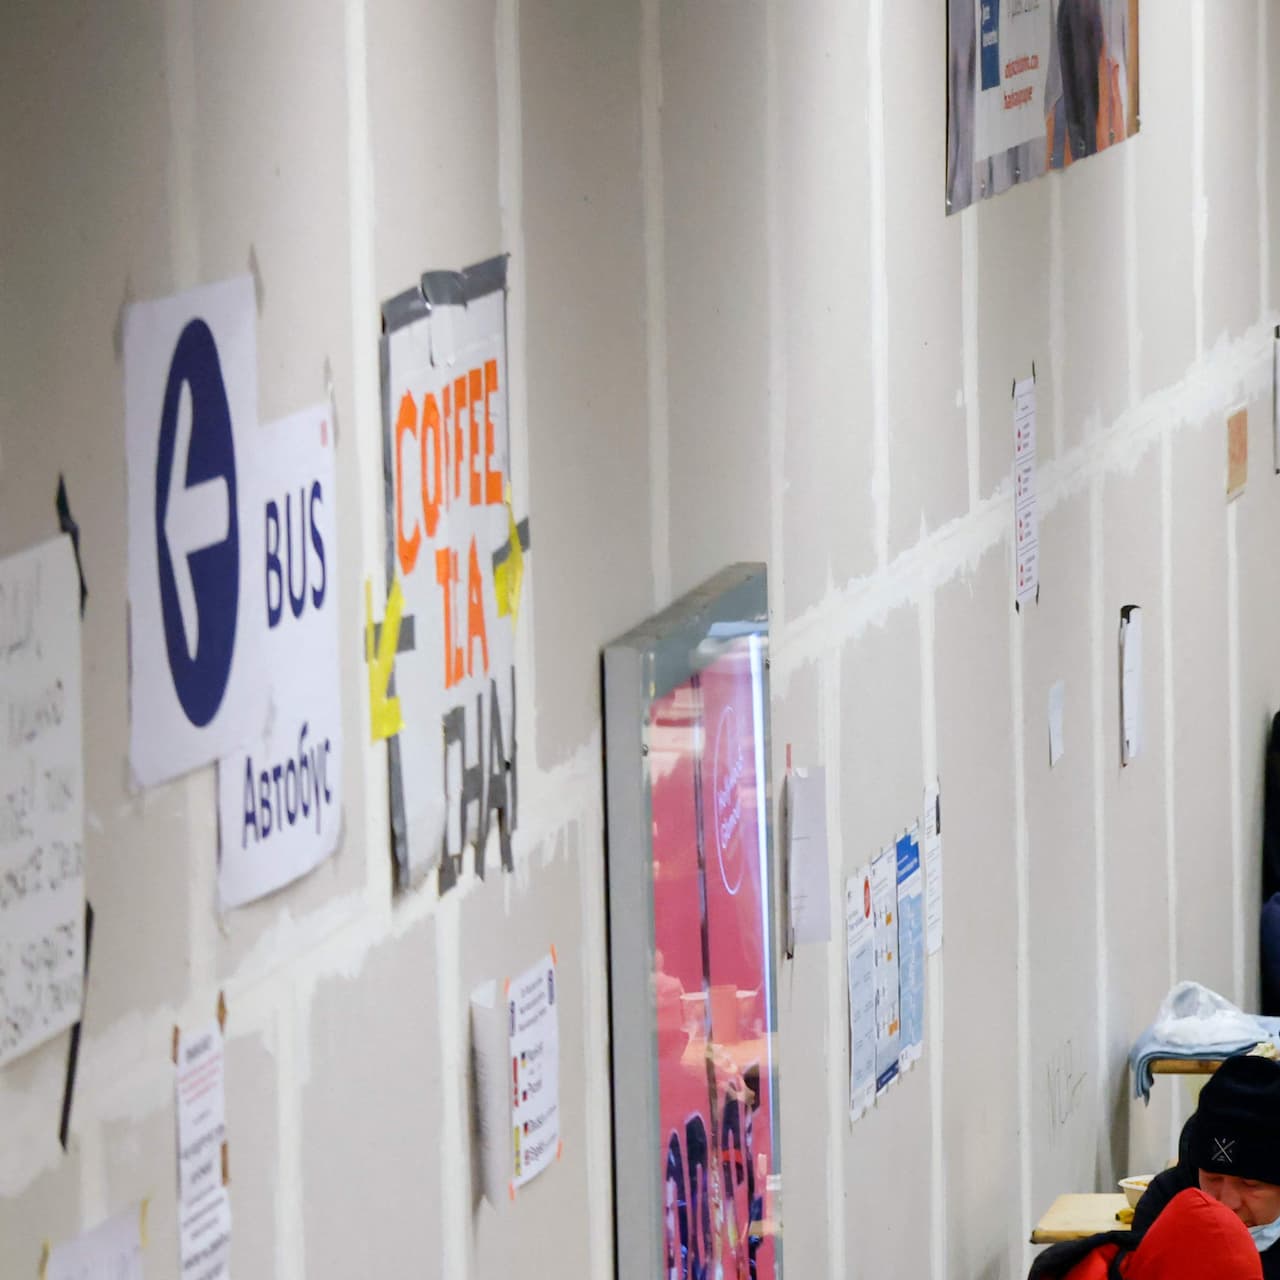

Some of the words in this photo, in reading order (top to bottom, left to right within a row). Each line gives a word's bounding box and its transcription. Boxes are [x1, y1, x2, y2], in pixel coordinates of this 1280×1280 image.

[394, 357, 503, 575] COFFEE
[265, 480, 326, 629] BUS
[435, 532, 489, 690] TEA
[242, 722, 333, 850] Автобус
